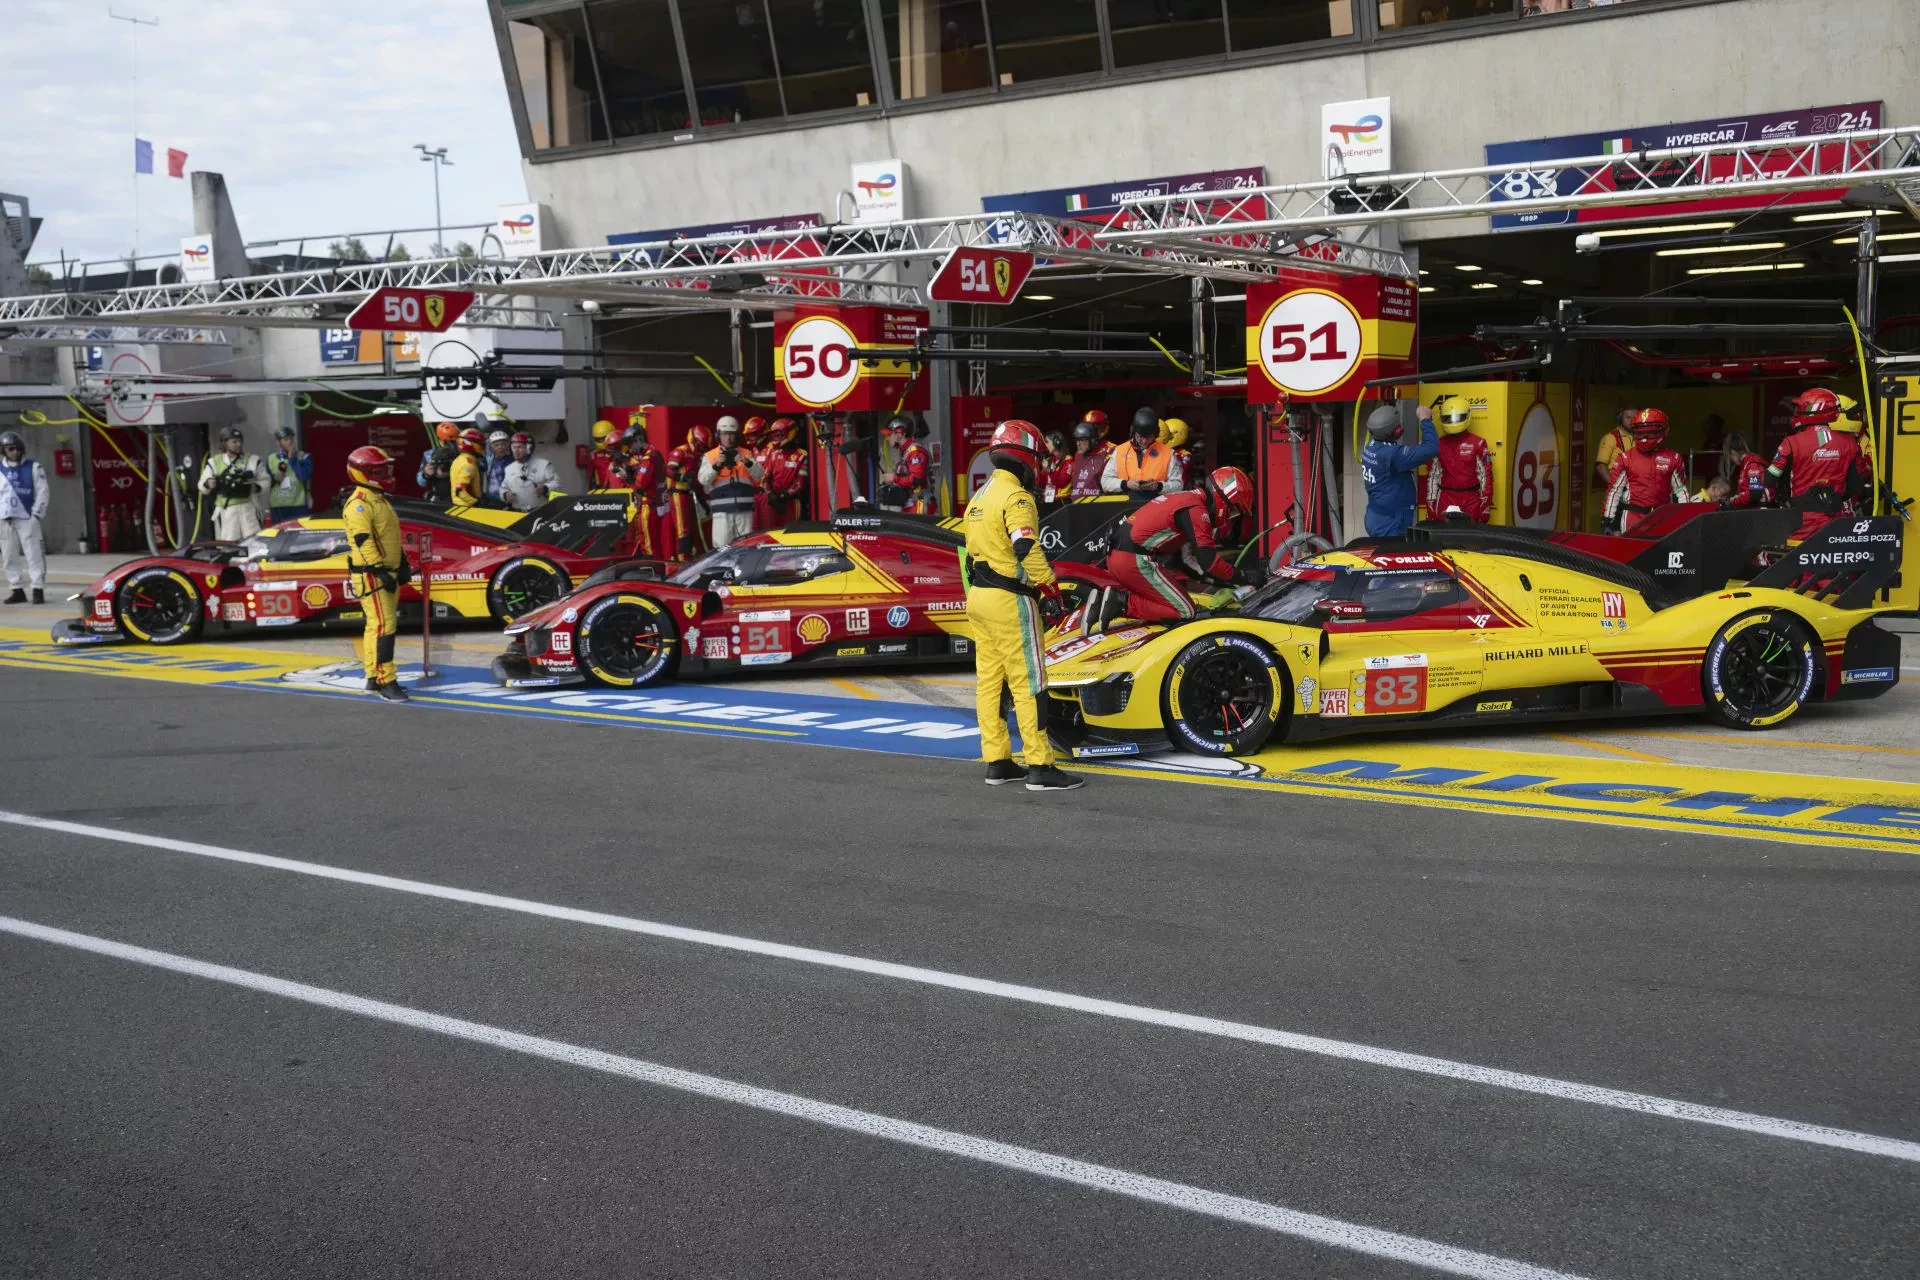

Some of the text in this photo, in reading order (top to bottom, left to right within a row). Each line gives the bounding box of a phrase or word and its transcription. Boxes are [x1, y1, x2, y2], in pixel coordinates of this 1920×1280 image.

[1666, 129, 1735, 148] HYPERCAR
[1761, 120, 1799, 134] WEC
[1330, 147, 1383, 158] ToalEnergies
[1504, 168, 1558, 199] 83
[1111, 189, 1161, 204] HYPERCAR
[960, 259, 990, 292] 51
[384, 296, 419, 323] 50
[1272, 321, 1347, 363] 51
[789, 343, 851, 379] 50
[1517, 451, 1555, 520] 83
[583, 502, 623, 512] Santander
[835, 518, 863, 527] ADLER
[1829, 534, 1896, 544] CHARLES POZZI
[1395, 556, 1434, 564] ORLEN
[412, 572, 485, 583] RIARD MILLE
[261, 594, 292, 614] 50
[587, 598, 616, 628] MICHELIN
[928, 601, 968, 611] RICHAR
[1604, 593, 1624, 617] HY
[223, 610, 244, 620] CAR
[891, 608, 907, 625] hp
[748, 627, 783, 650] 51
[0, 640, 281, 672] CHELIN
[541, 657, 574, 666] V-Power
[703, 646, 726, 657] CAR
[1232, 639, 1270, 665] MICHELIN
[1485, 644, 1588, 662] RICHARD MILLE
[1455, 669, 1482, 677] DEALERS
[1711, 642, 1726, 688] MICHELIN
[1852, 671, 1889, 679] MICHELIN
[1800, 658, 1814, 702] MICHELIN
[1374, 675, 1418, 706] 83
[412, 681, 981, 740] MICHELIN
[1480, 702, 1509, 711] Sabelt
[1179, 722, 1218, 751] MICHELIN
[1090, 745, 1133, 754] MICHELIN
